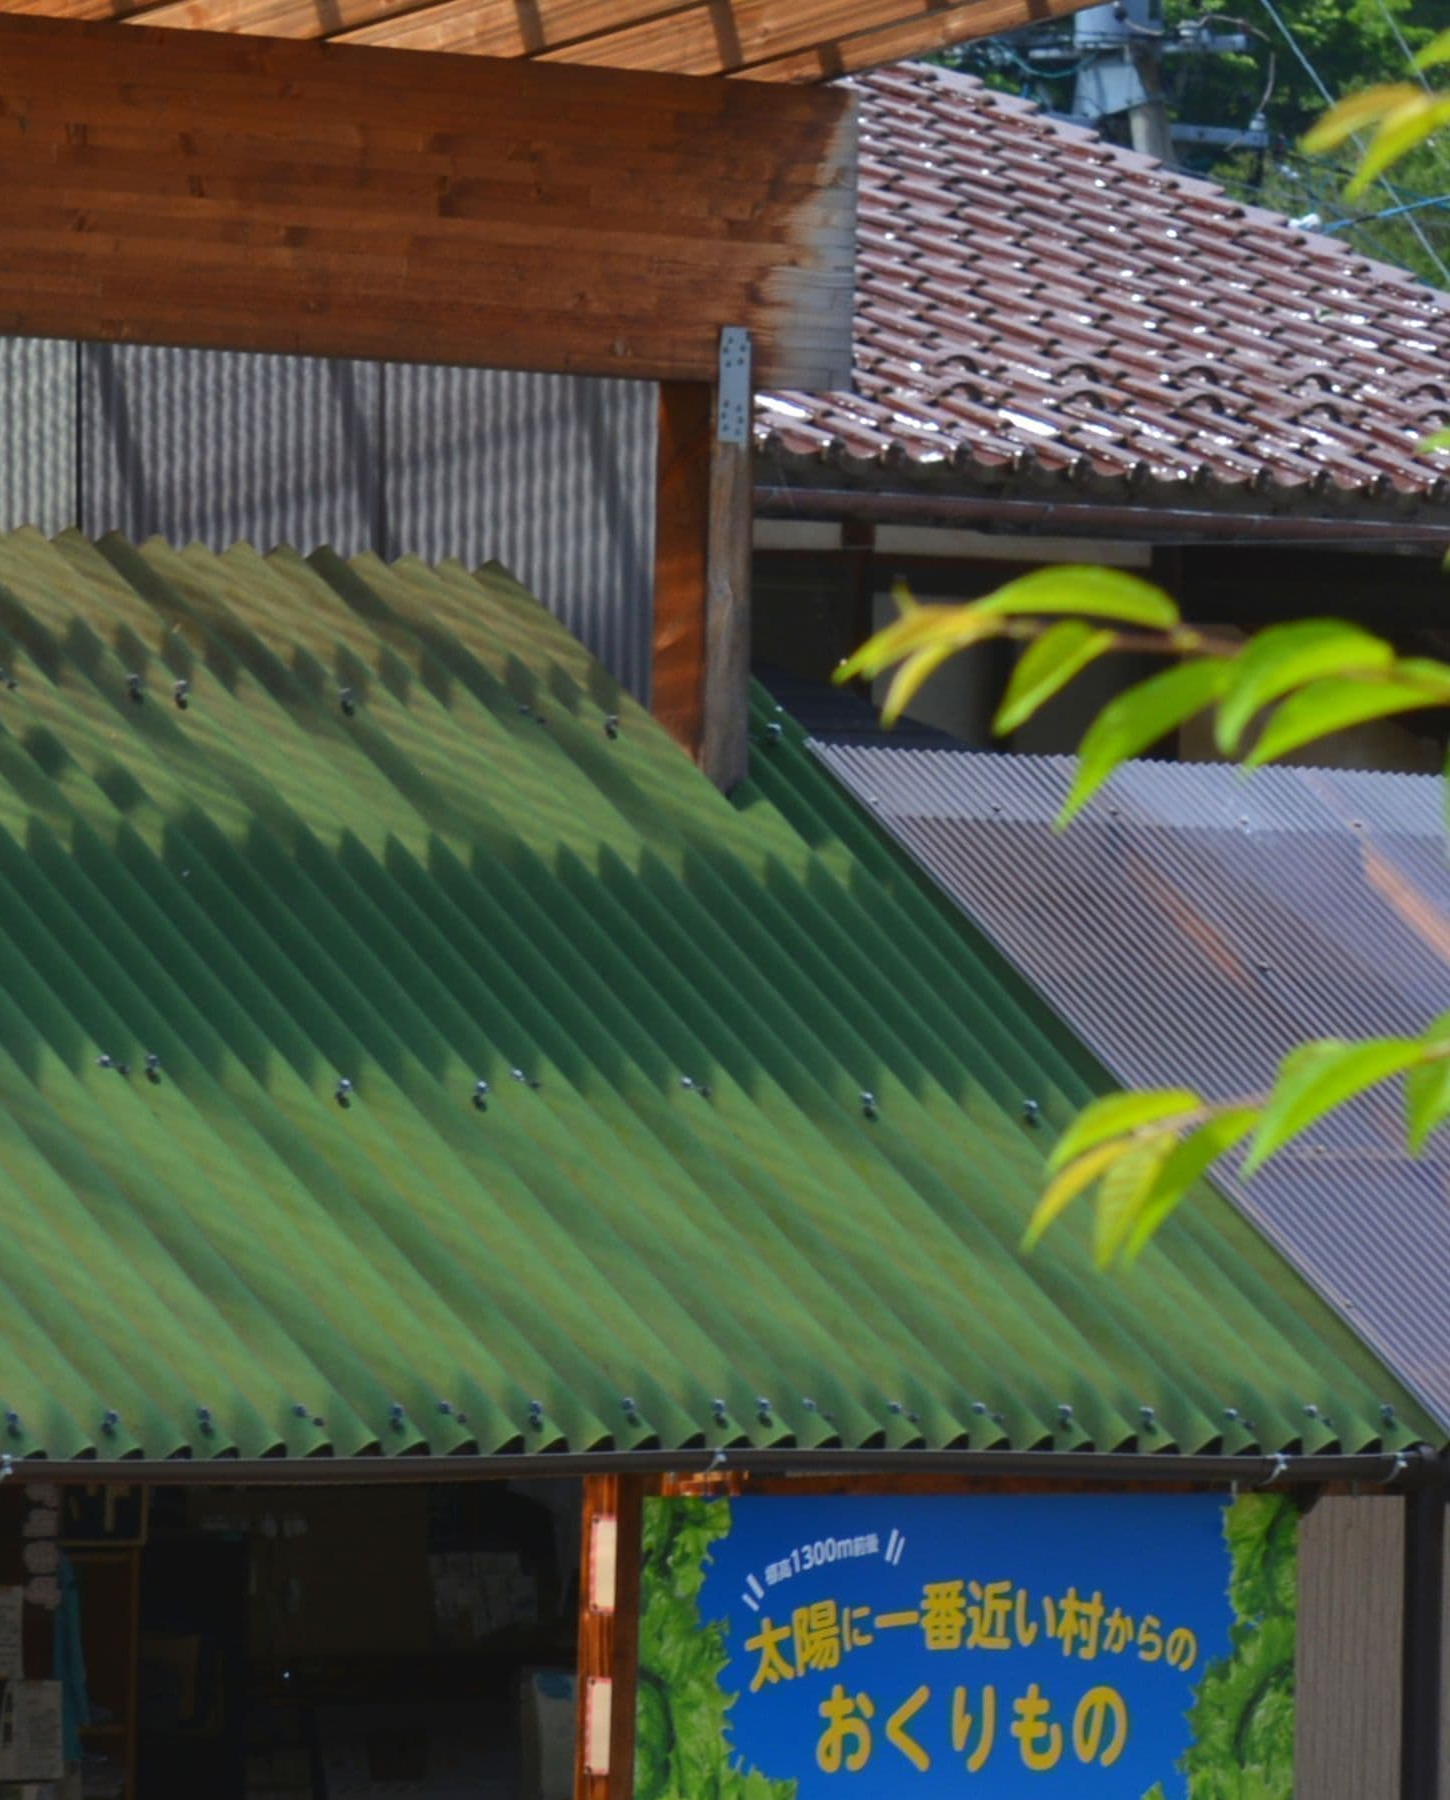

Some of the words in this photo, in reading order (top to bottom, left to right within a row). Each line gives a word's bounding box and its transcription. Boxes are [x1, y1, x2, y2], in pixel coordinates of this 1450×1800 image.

[744, 1579, 1197, 1693] 太陽に一番近い村からの
[815, 1683, 1128, 1773] おくりもの
